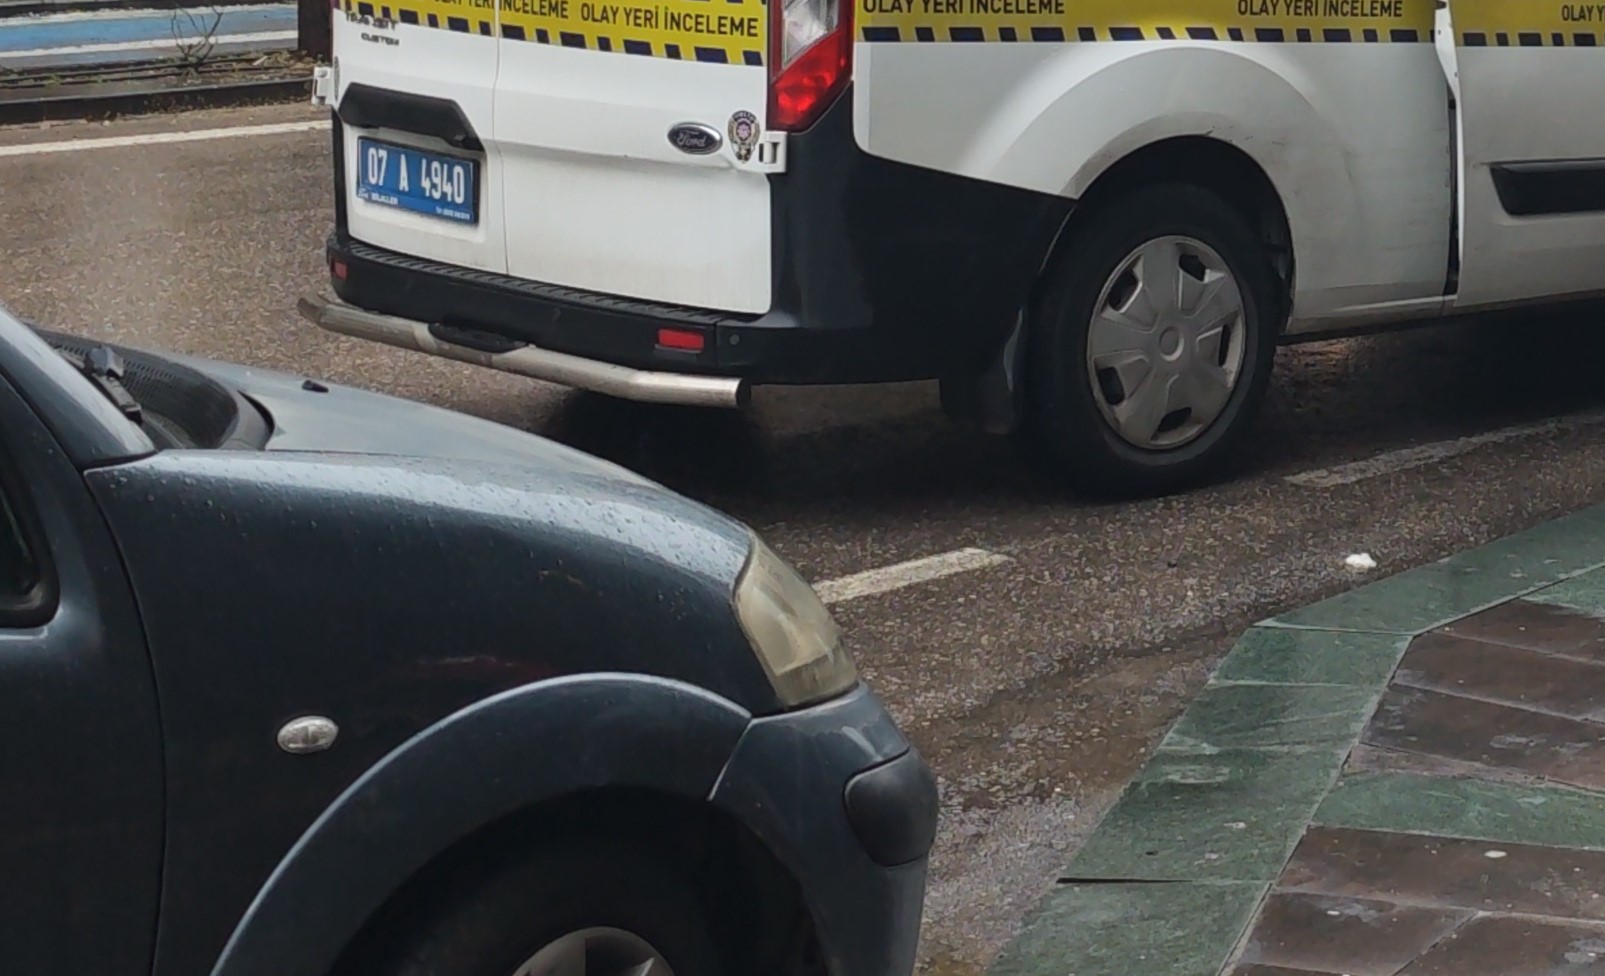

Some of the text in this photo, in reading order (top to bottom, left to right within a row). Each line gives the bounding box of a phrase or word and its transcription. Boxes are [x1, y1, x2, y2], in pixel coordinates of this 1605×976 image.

[581, 2, 759, 37] OLAY YERİ İNCELEME
[1561, 4, 1595, 22] OLAY
[367, 147, 465, 204] 07 A 4940
